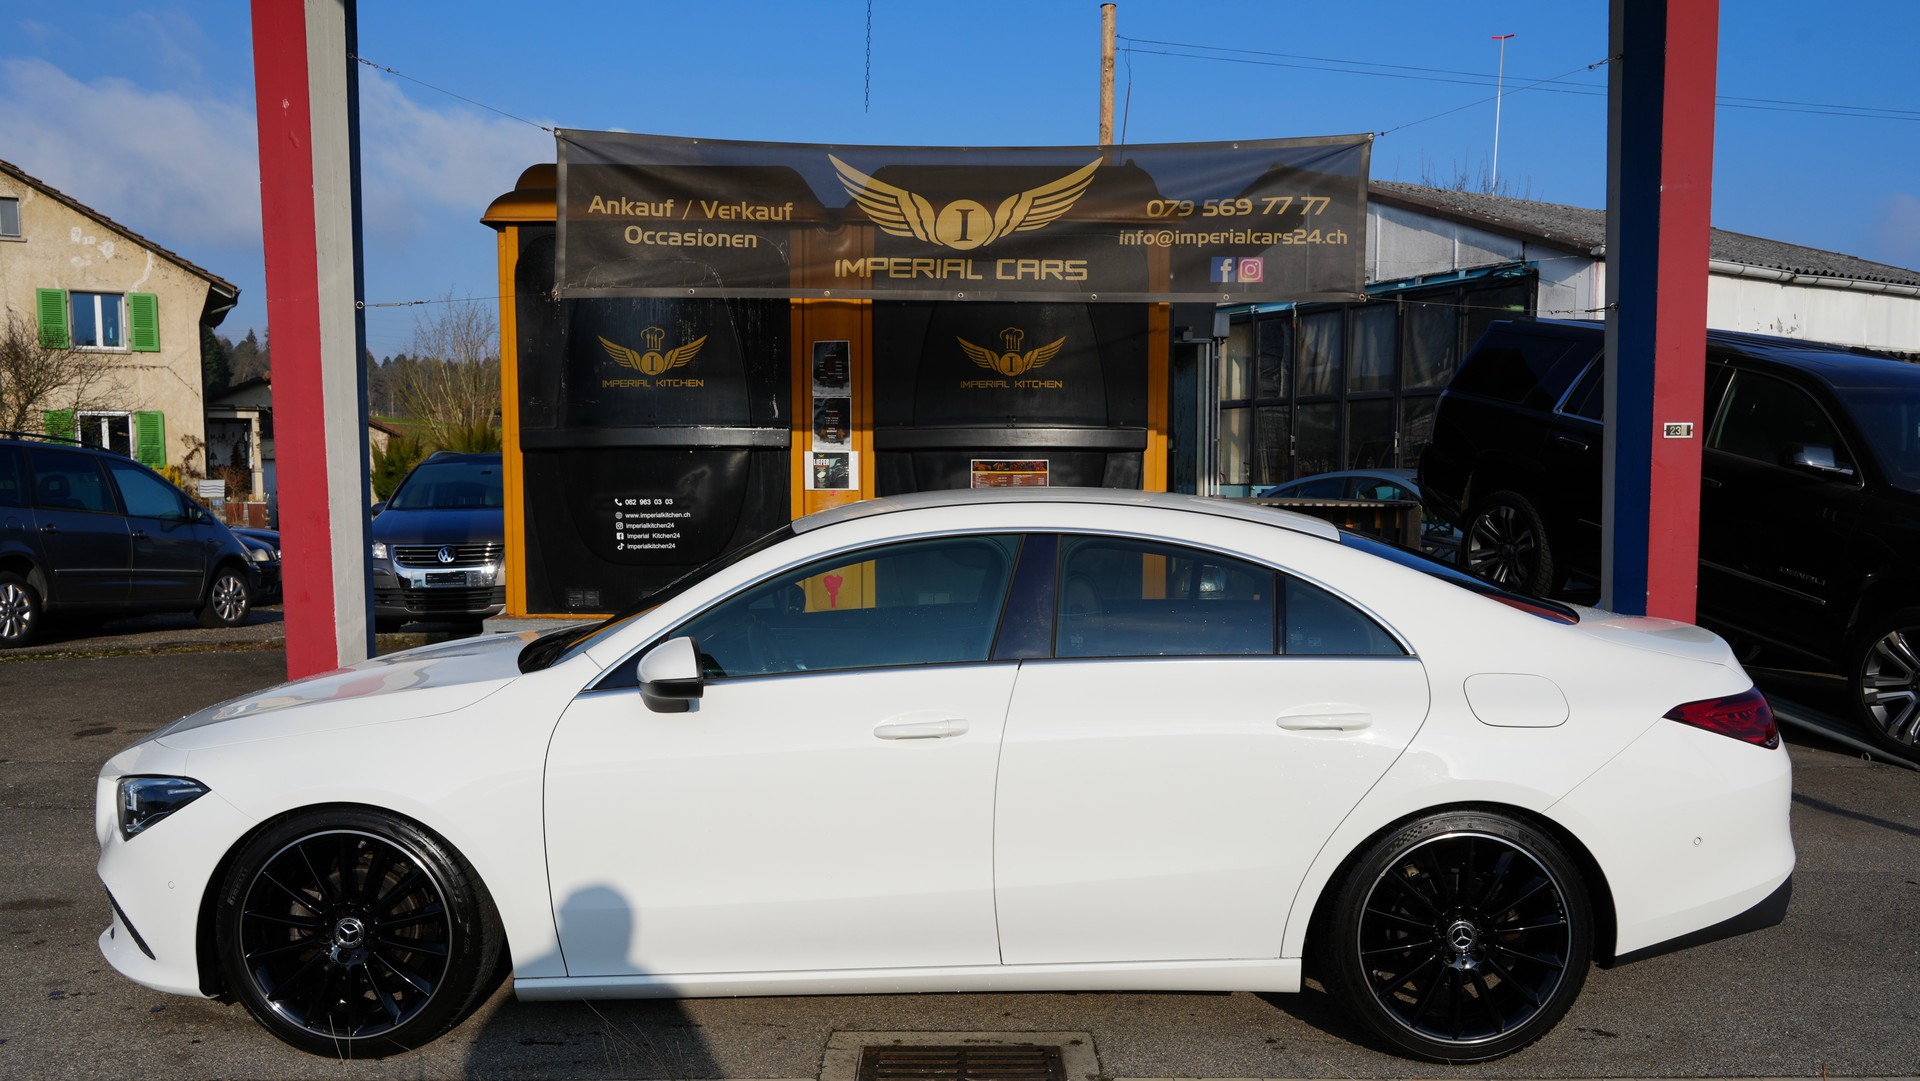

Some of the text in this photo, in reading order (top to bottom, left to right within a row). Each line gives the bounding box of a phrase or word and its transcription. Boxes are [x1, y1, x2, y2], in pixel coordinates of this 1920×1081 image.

[588, 195, 793, 221] Ankauf / Verkauf
[1146, 196, 1331, 217] 079 569 77 77
[624, 225, 757, 248] Occasionen
[1119, 228, 1348, 247] info@imperialcars24.ch
[834, 257, 1088, 281] IMPERIAL CARS
[602, 379, 704, 388] IMPERIAL KITCHEN
[960, 379, 1062, 388] IMPERIAL KITCHEN
[1670, 425, 1681, 436] 23
[625, 511, 691, 519] www.imperialkitchen.ch
